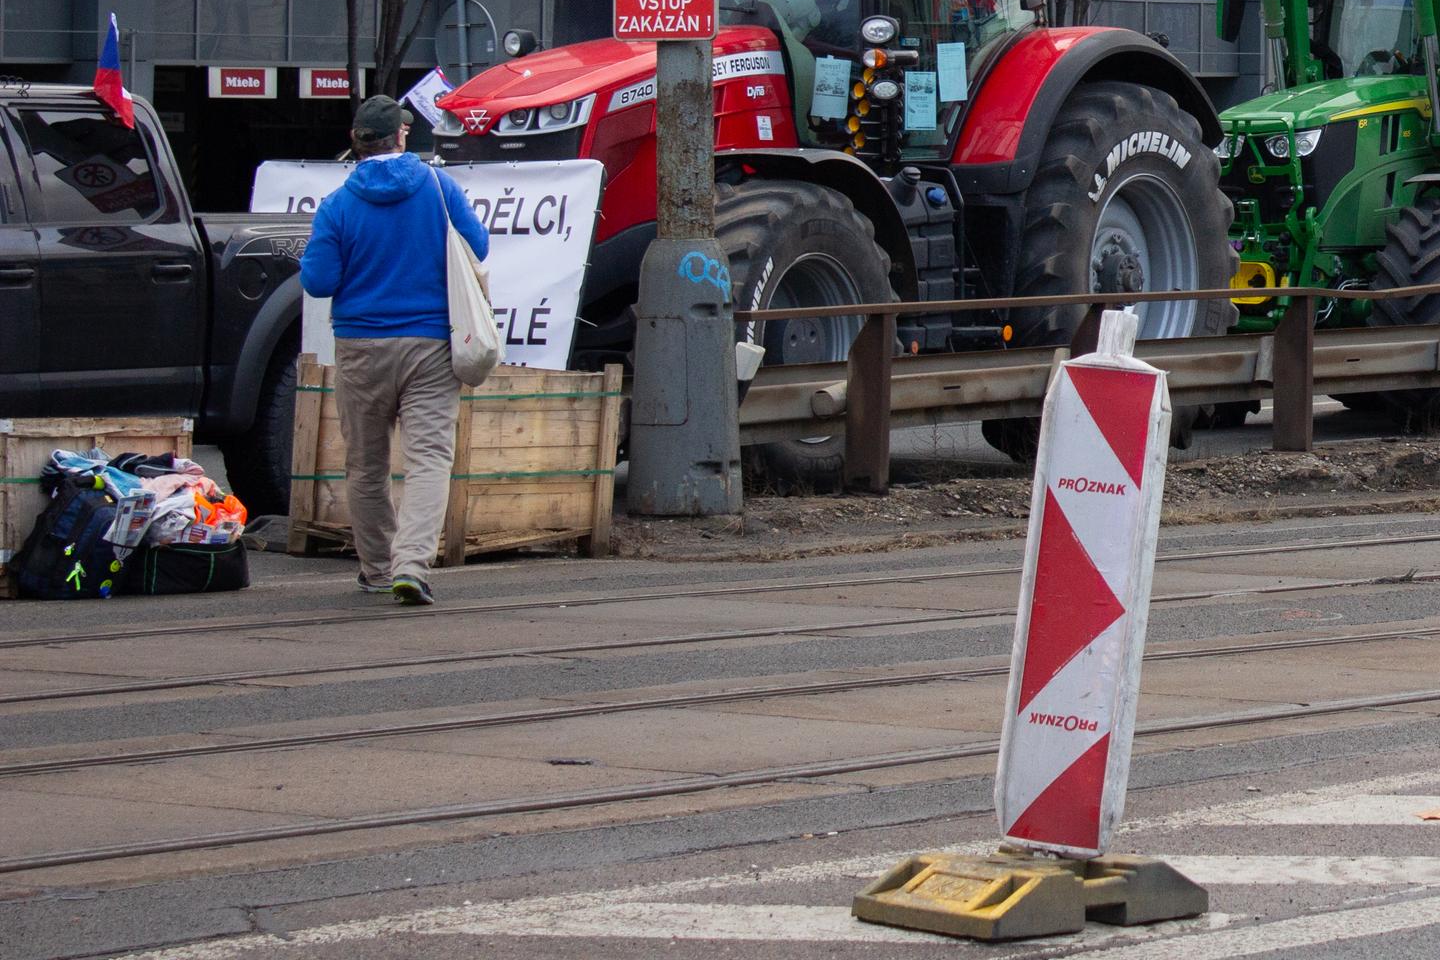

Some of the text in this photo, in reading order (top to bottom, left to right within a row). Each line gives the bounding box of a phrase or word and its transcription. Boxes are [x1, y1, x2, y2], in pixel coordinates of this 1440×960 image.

[618, 11, 700, 32] ZAKÁZÁN
[730, 56, 771, 73] FERGUSON
[225, 76, 261, 88] Miele
[316, 77, 350, 89] Miele
[621, 84, 653, 104] 8740
[1105, 130, 1192, 178] MICHELIN
[1058, 477, 1127, 496] PROZNAK
[1029, 712, 1099, 732] PROZNAK
